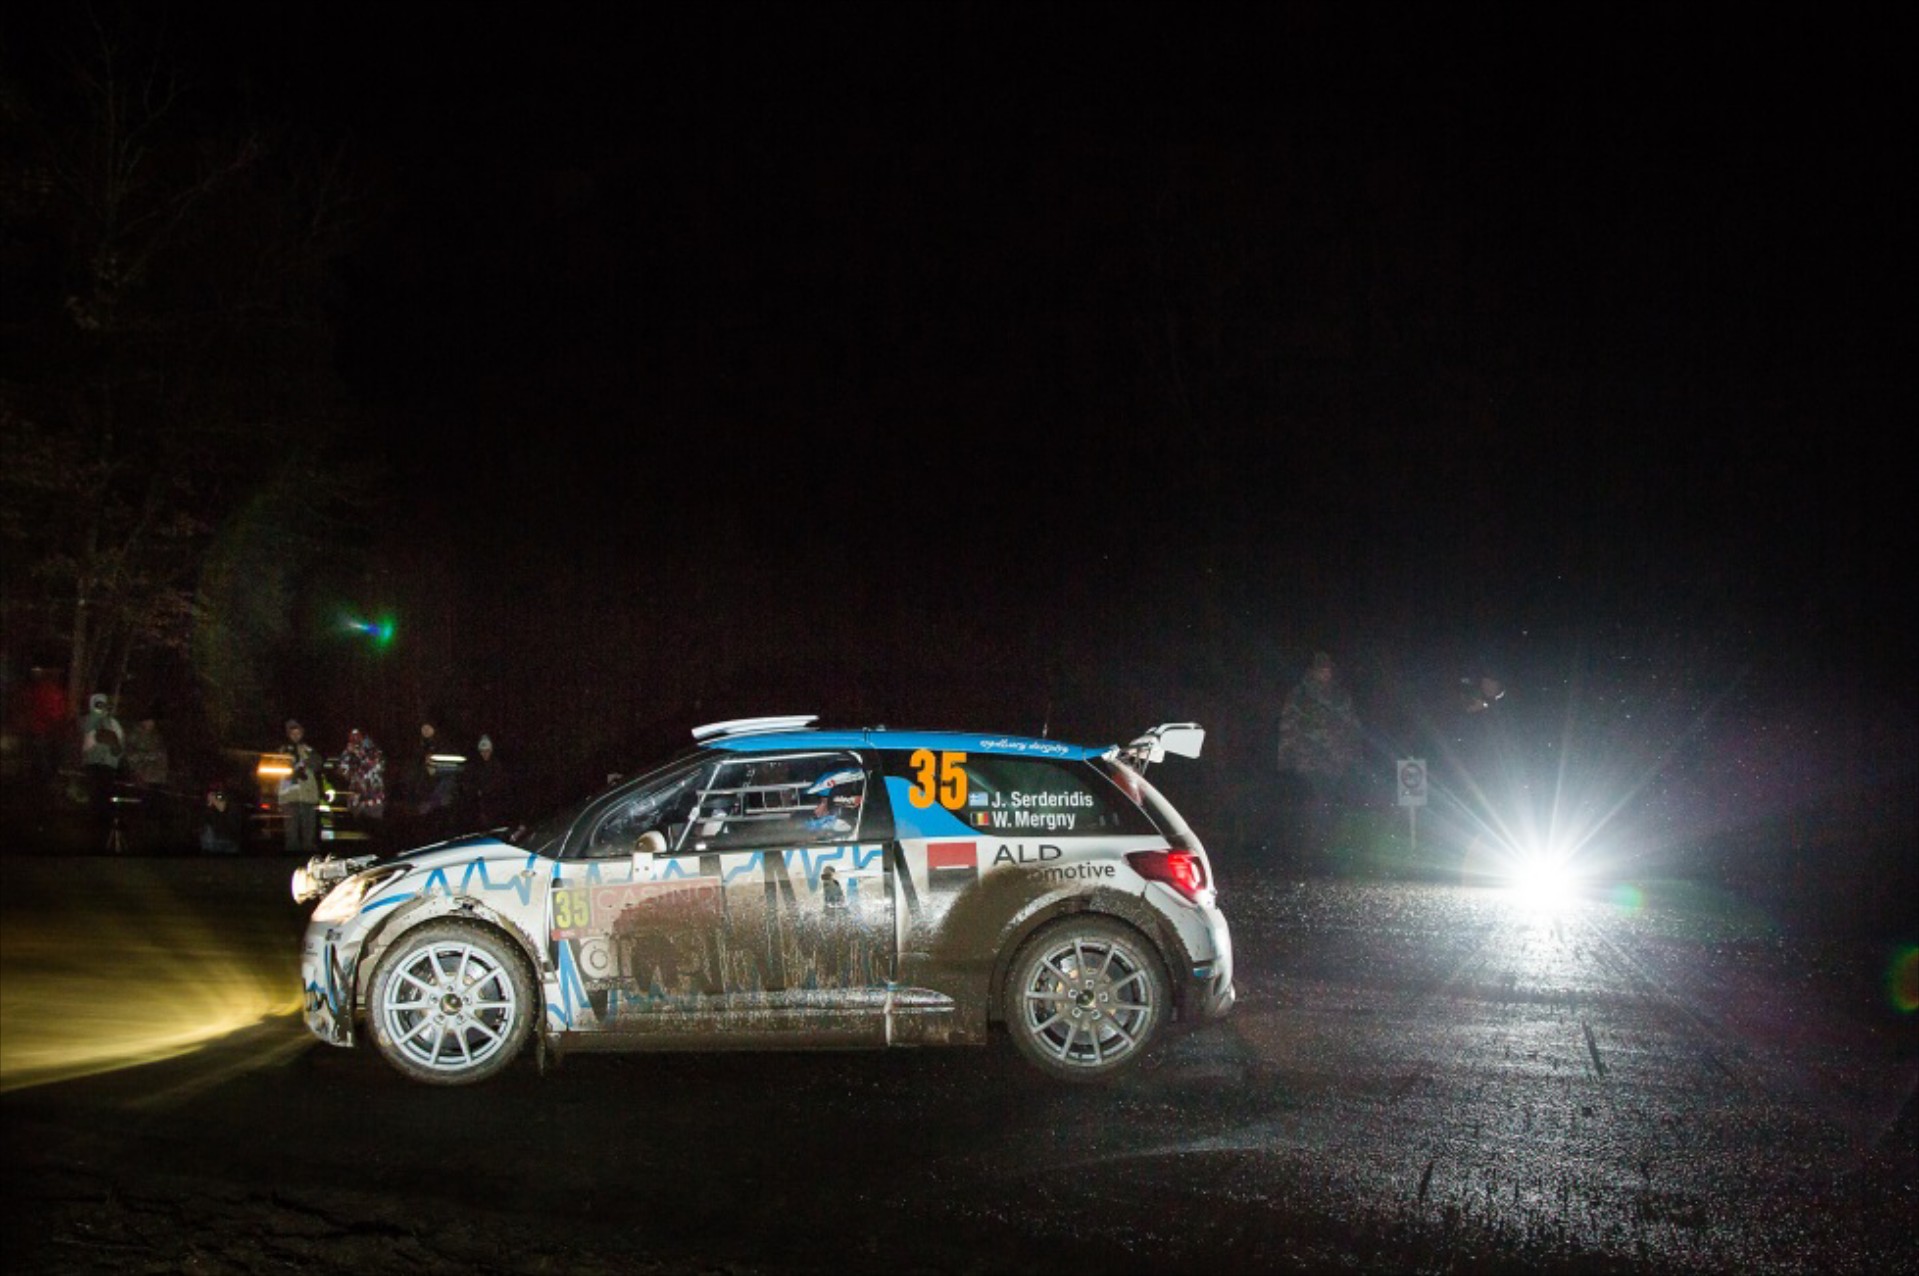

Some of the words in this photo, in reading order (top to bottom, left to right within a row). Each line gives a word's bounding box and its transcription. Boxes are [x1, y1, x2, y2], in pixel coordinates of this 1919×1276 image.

[908, 748, 969, 811] 35
[991, 792, 1007, 808] J.
[1010, 791, 1094, 807] Serderidis
[992, 811, 1012, 828] W.
[1015, 811, 1076, 830] Mergny
[992, 843, 1063, 866] ALD
[556, 889, 590, 929] 35
